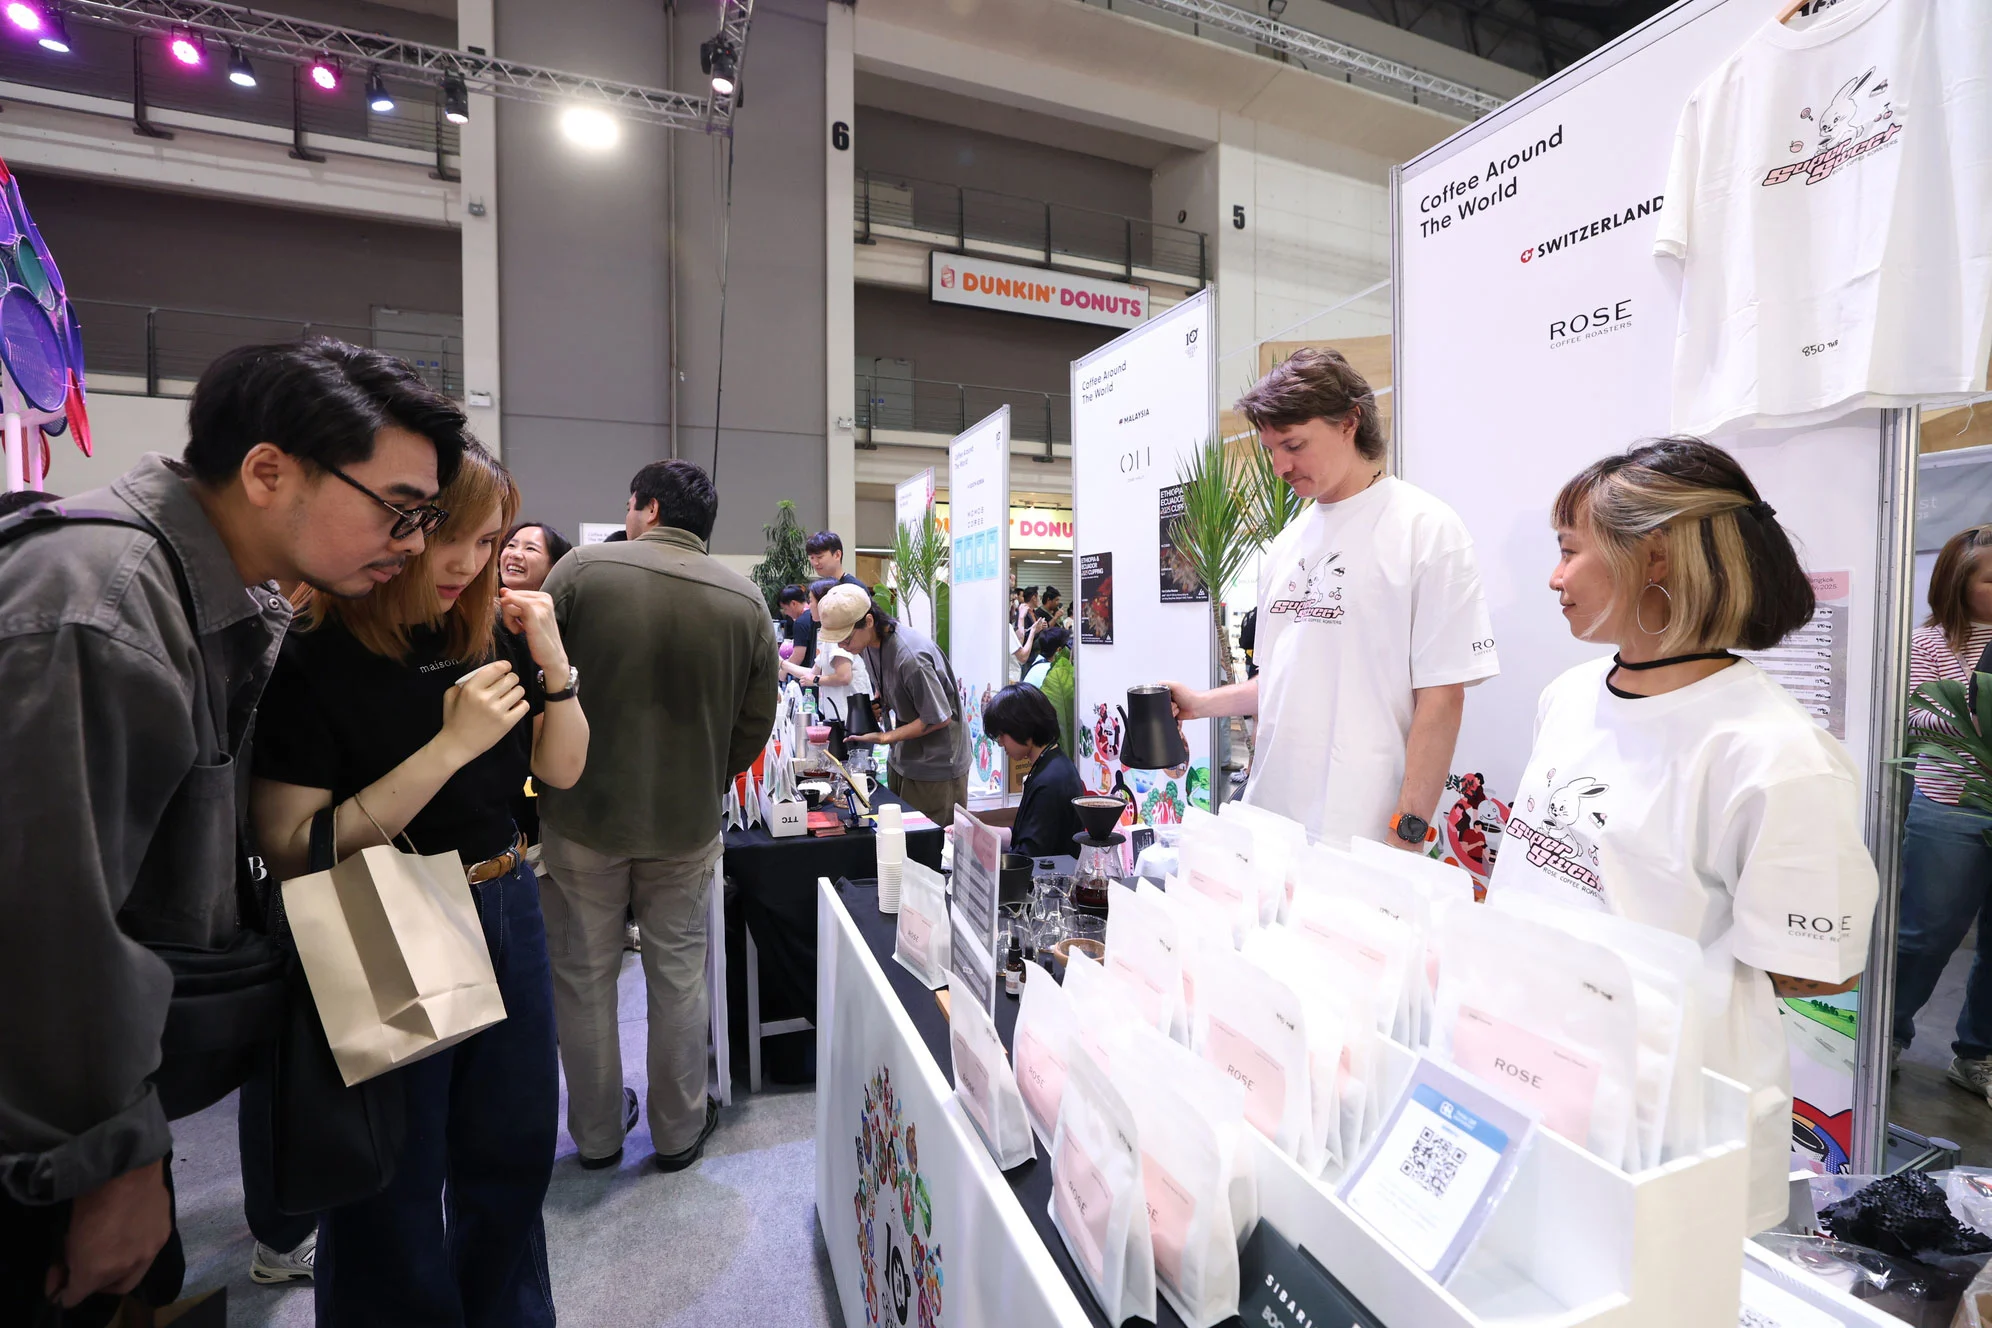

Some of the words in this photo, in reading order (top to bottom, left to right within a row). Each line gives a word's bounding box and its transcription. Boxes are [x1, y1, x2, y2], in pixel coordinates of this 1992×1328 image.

[832, 121, 850, 151] 6
[1420, 175, 1479, 213] Coffee
[1486, 124, 1564, 182] Around
[1233, 204, 1246, 230] 5
[1420, 214, 1452, 239] The
[1458, 176, 1518, 221] World
[1537, 195, 1665, 259] SWITZERLAND
[962, 272, 1056, 303] DUNKIN'
[1060, 287, 1142, 318] DONUTS
[1549, 299, 1633, 341] ROSE
[1549, 334, 1583, 350] COFFEE
[1585, 320, 1633, 340] ROASTERS
[1802, 343, 1826, 357] 850
[1081, 374, 1102, 391] Coffee
[1103, 360, 1127, 380] Around
[1081, 393, 1094, 404] The
[1095, 382, 1114, 398] World
[1123, 408, 1150, 424] MALAYSIA
[1810, 576, 1834, 585] angkok
[419, 657, 460, 673] maison
[1788, 913, 1852, 933] ROE
[1788, 930, 1825, 941] COFFEE
[1028, 1066, 1046, 1089] ROSE
[1227, 1064, 1255, 1091] ROSE
[1494, 1057, 1544, 1090] ROSE
[1068, 1180, 1088, 1217] ROSE
[1146, 1202, 1159, 1223] SE
